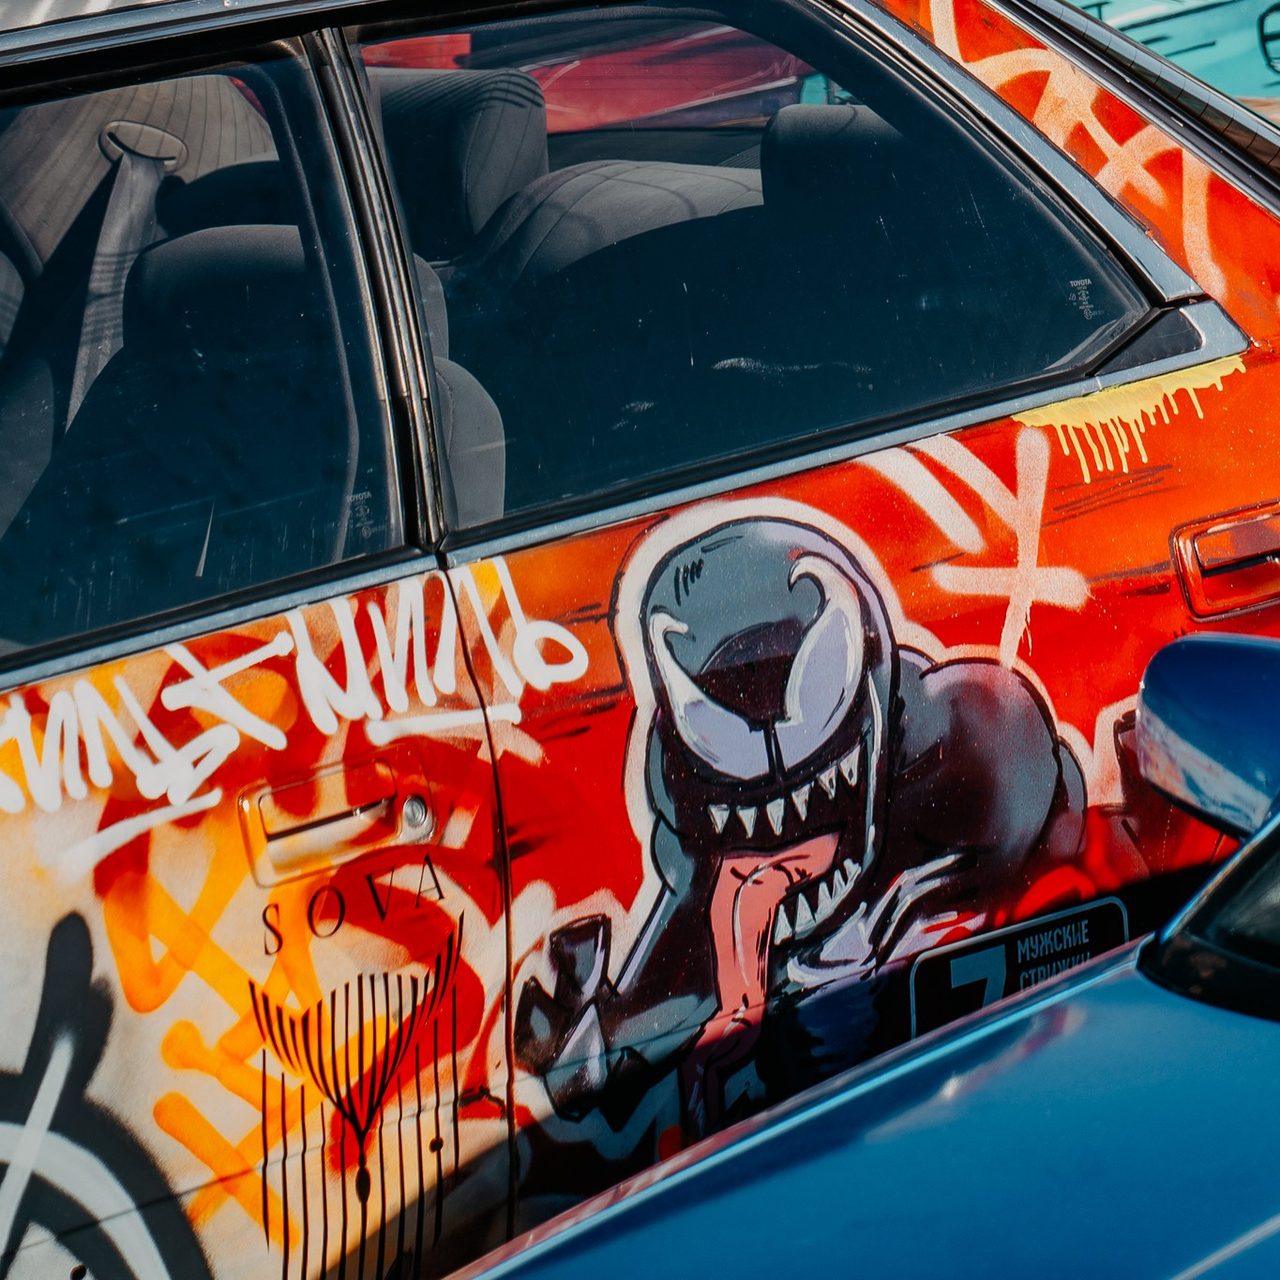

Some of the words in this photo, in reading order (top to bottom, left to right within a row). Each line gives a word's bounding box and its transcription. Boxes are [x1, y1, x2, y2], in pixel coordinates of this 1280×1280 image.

[1069, 278, 1092, 287] TOYOTA
[262, 853, 444, 956] SOVA
[1017, 919, 1090, 964] МУЖСКИЕ
